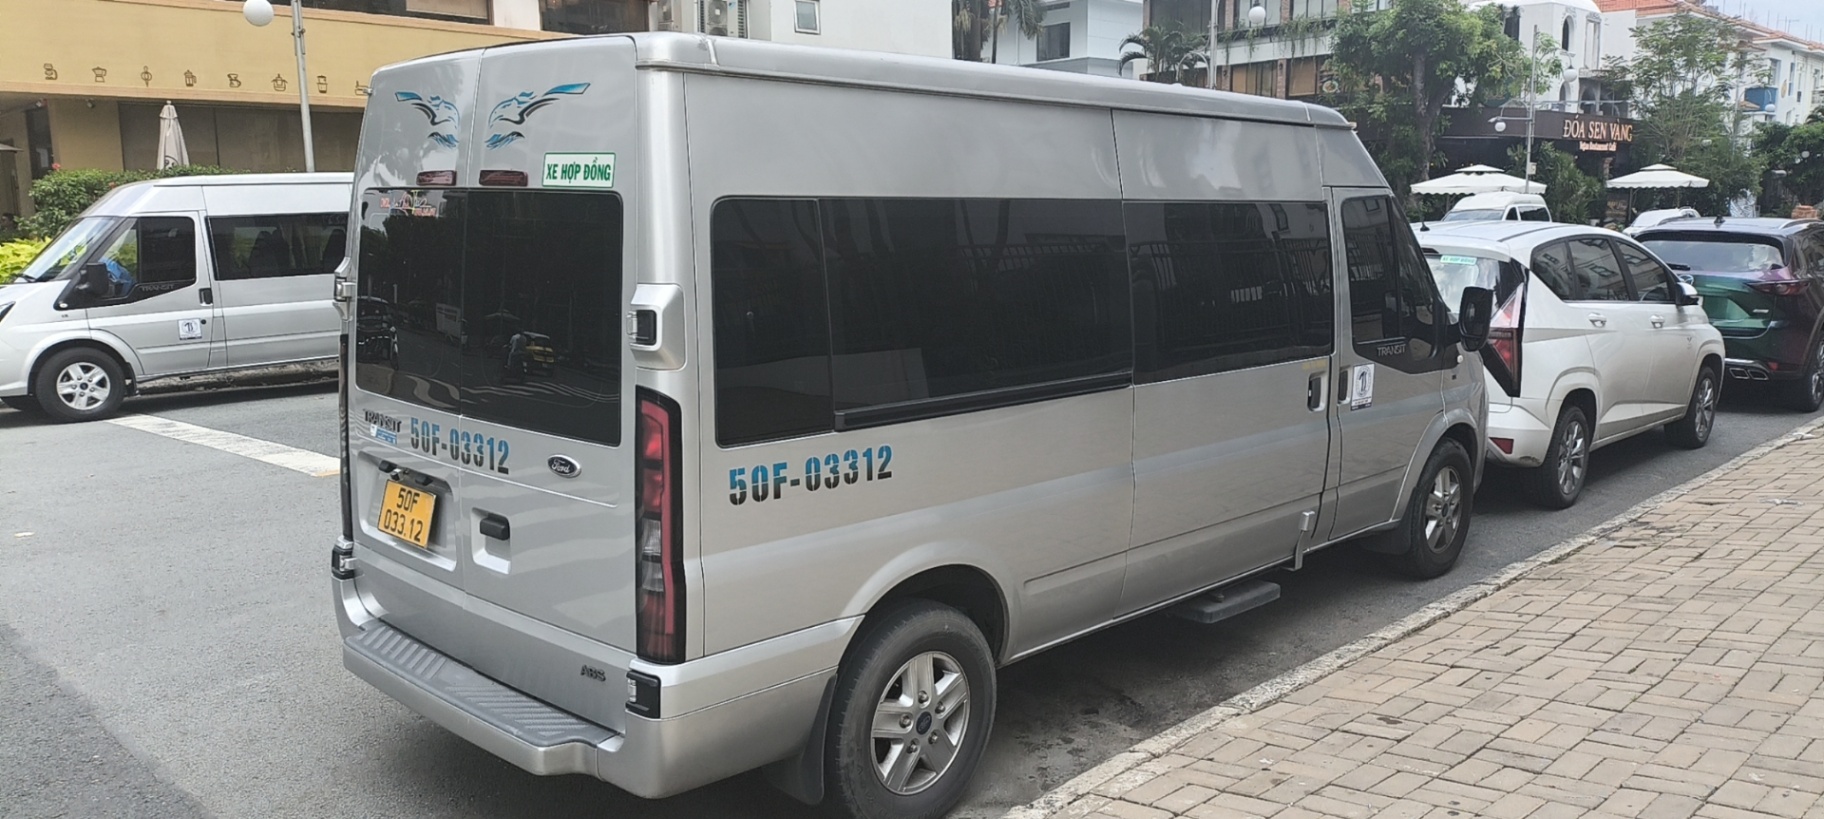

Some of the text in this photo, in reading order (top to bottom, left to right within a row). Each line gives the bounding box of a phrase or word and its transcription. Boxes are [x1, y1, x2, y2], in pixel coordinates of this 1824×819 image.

[1563, 115, 1633, 142] ĐÓA SEN VÀNG
[546, 156, 611, 184] XE HỢP ĐỒNG
[1377, 343, 1406, 356] TRANSIT
[363, 409, 402, 433] TRANSIT
[411, 417, 509, 474] 50F-03312
[729, 445, 893, 505] 50F-03312
[396, 487, 420, 512] 50F
[384, 509, 423, 542] 033.12
[580, 664, 606, 682] ABS
